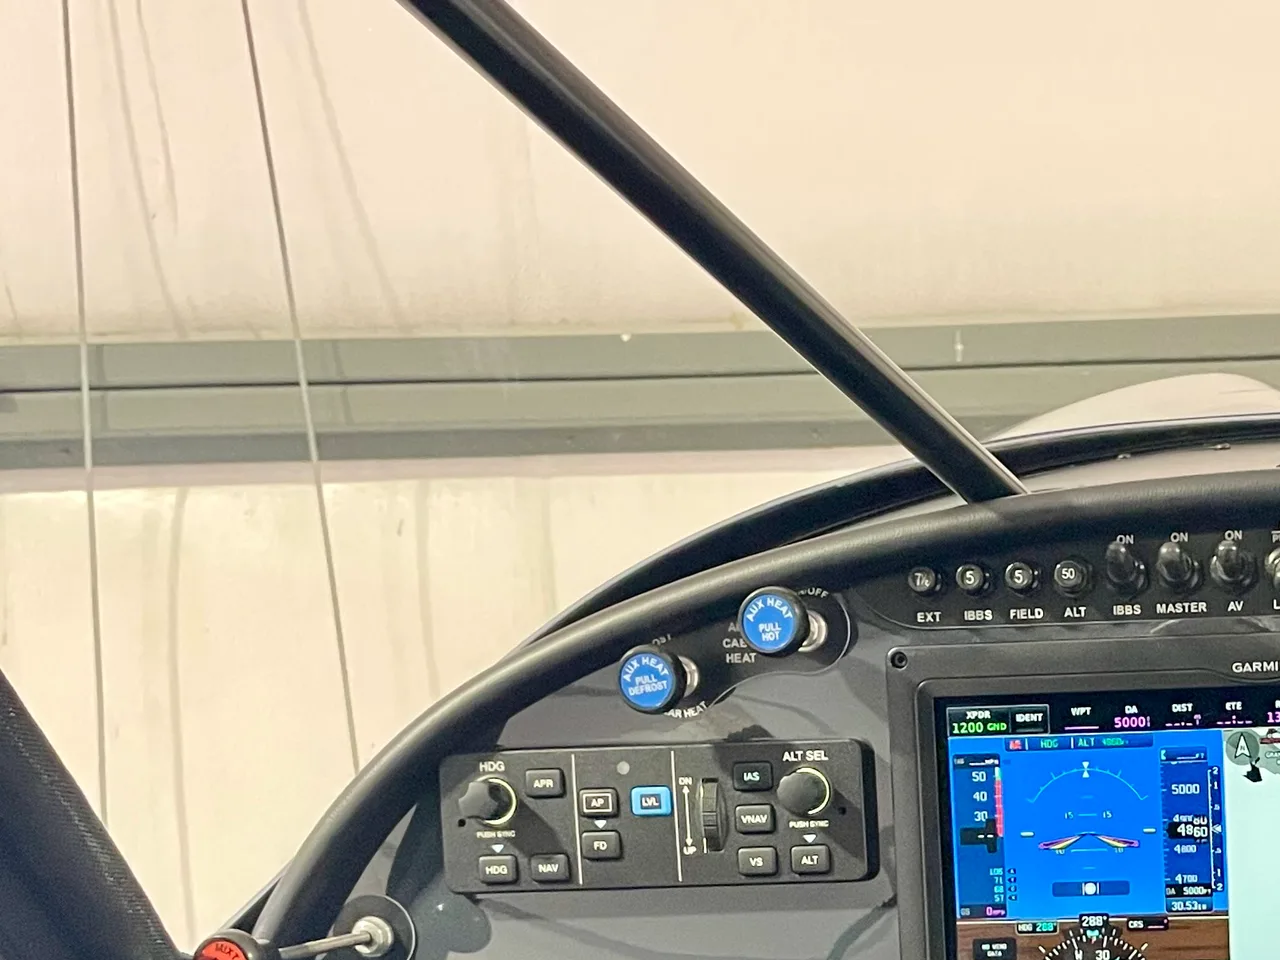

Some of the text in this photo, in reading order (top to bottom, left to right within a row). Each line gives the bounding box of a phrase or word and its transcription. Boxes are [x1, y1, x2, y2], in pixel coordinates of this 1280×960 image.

[1116, 533, 1134, 544] ON
[1170, 532, 1188, 543] ON
[1224, 530, 1242, 541] ON
[965, 570, 975, 584] 5
[1014, 569, 1023, 584] 5
[1062, 567, 1075, 580] 50
[746, 597, 792, 622] AUX HEAT
[1064, 606, 1086, 618] ALT
[1112, 604, 1141, 616] IBBS
[1156, 602, 1207, 614] MASTER
[1228, 601, 1244, 612] AV
[917, 611, 941, 623] EXT
[964, 609, 993, 621] IBBS
[1010, 608, 1044, 620] FIELD
[759, 622, 781, 633] PULL
[762, 632, 780, 642] HOT
[725, 652, 757, 664] HEAT
[623, 656, 668, 682] AUX HEAT
[635, 676, 657, 686] PULL
[628, 680, 668, 696] DEFROST
[682, 700, 707, 718] HEAT
[1071, 706, 1092, 716] WPT
[1125, 705, 1138, 714] DA
[1172, 703, 1193, 712] DIST
[1226, 702, 1242, 710] ETE
[966, 711, 991, 720] XPDR
[1016, 713, 1044, 722] IDENT
[952, 722, 984, 734] 1200
[782, 750, 828, 762] ALT SEL
[479, 761, 505, 772] HDG
[744, 772, 760, 782] IAS
[972, 771, 986, 782] 50
[534, 779, 554, 788] APR
[1172, 784, 1200, 795] 5000
[642, 797, 659, 806] LVL
[973, 791, 988, 802] 40
[590, 798, 604, 807] AP
[741, 814, 767, 824] VNAV
[594, 841, 608, 850] FD
[684, 846, 696, 855] UP
[750, 858, 764, 866] VS
[801, 856, 818, 865] ALT
[485, 866, 508, 875] HDG
[538, 864, 559, 872] NAV
[1096, 950, 1110, 960] 30
